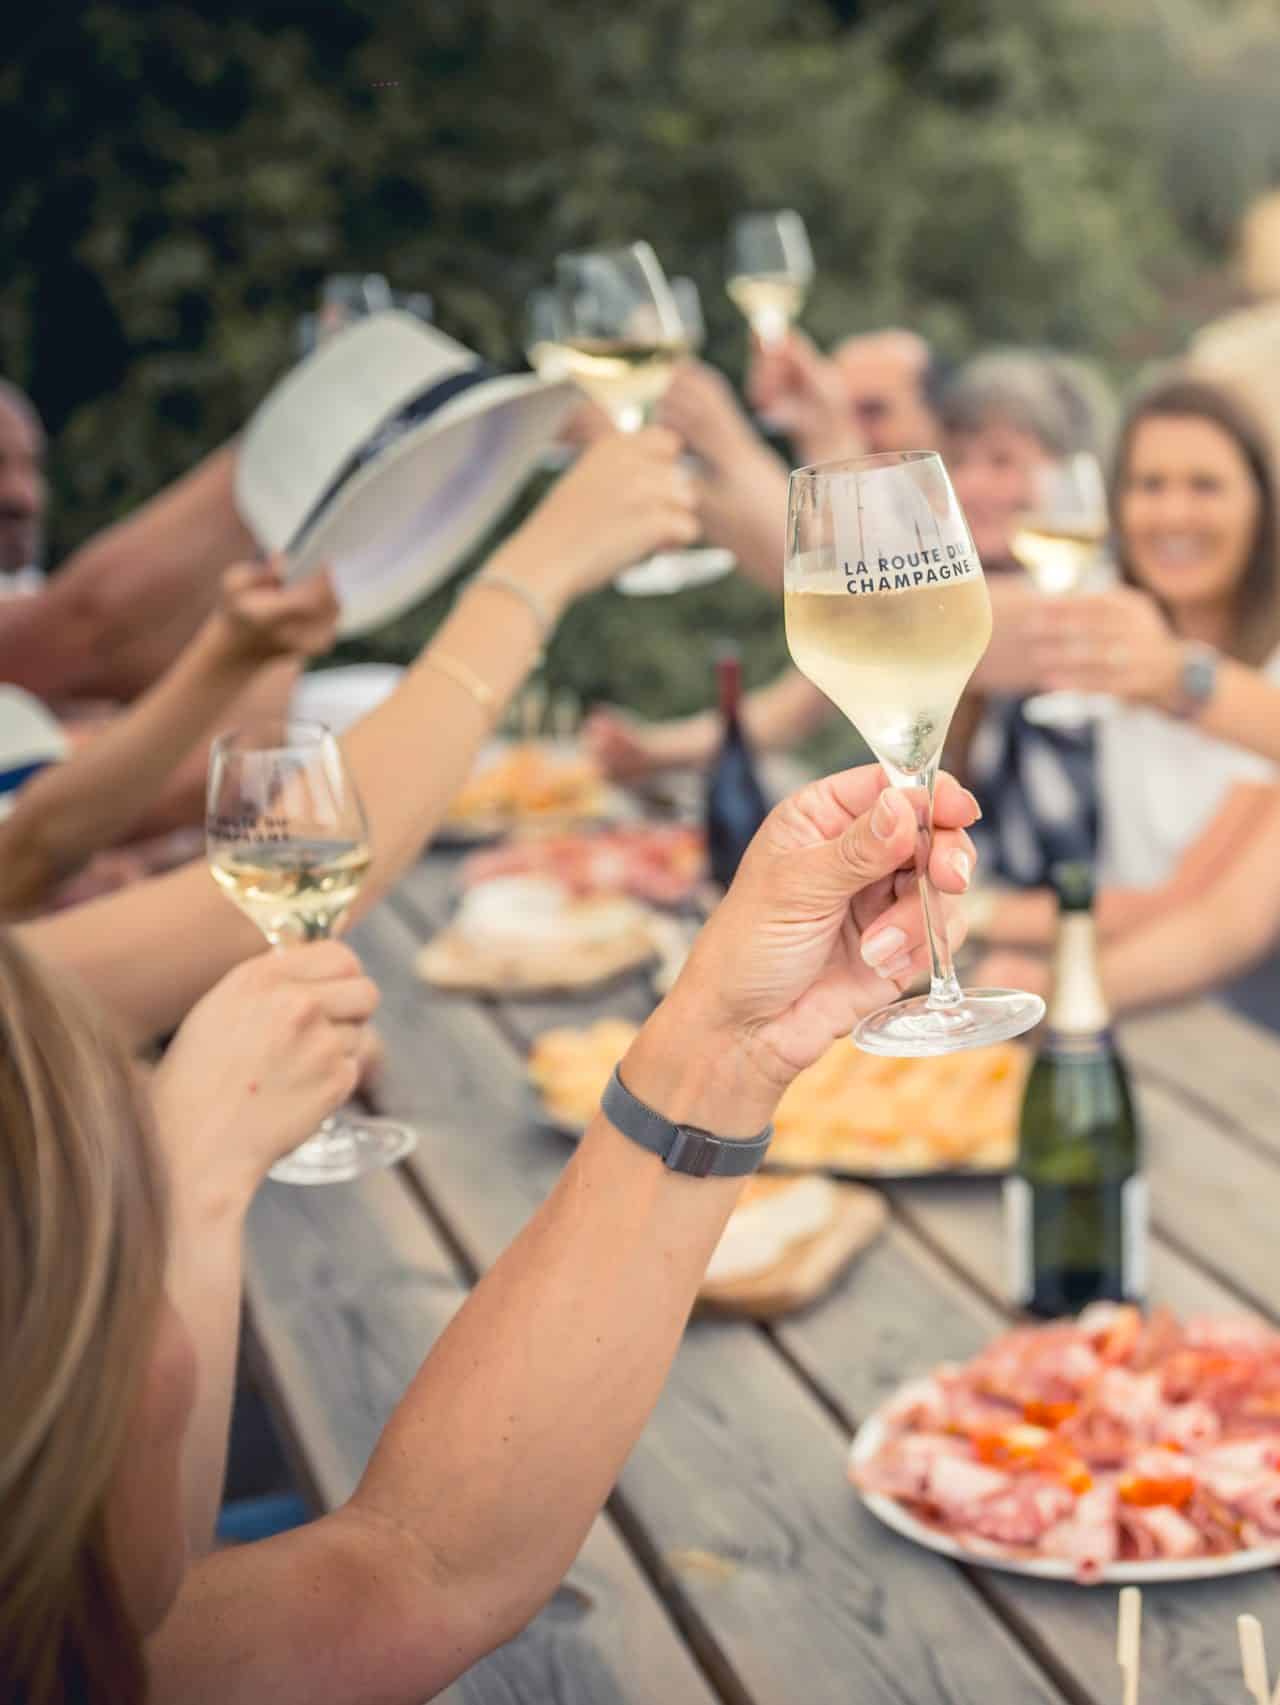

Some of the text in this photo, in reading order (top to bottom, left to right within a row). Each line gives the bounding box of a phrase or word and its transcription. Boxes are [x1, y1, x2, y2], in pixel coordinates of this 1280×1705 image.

[844, 561, 868, 576] LA
[878, 548, 940, 572] ROUTE
[847, 559, 971, 594] CHAMPAGNE
